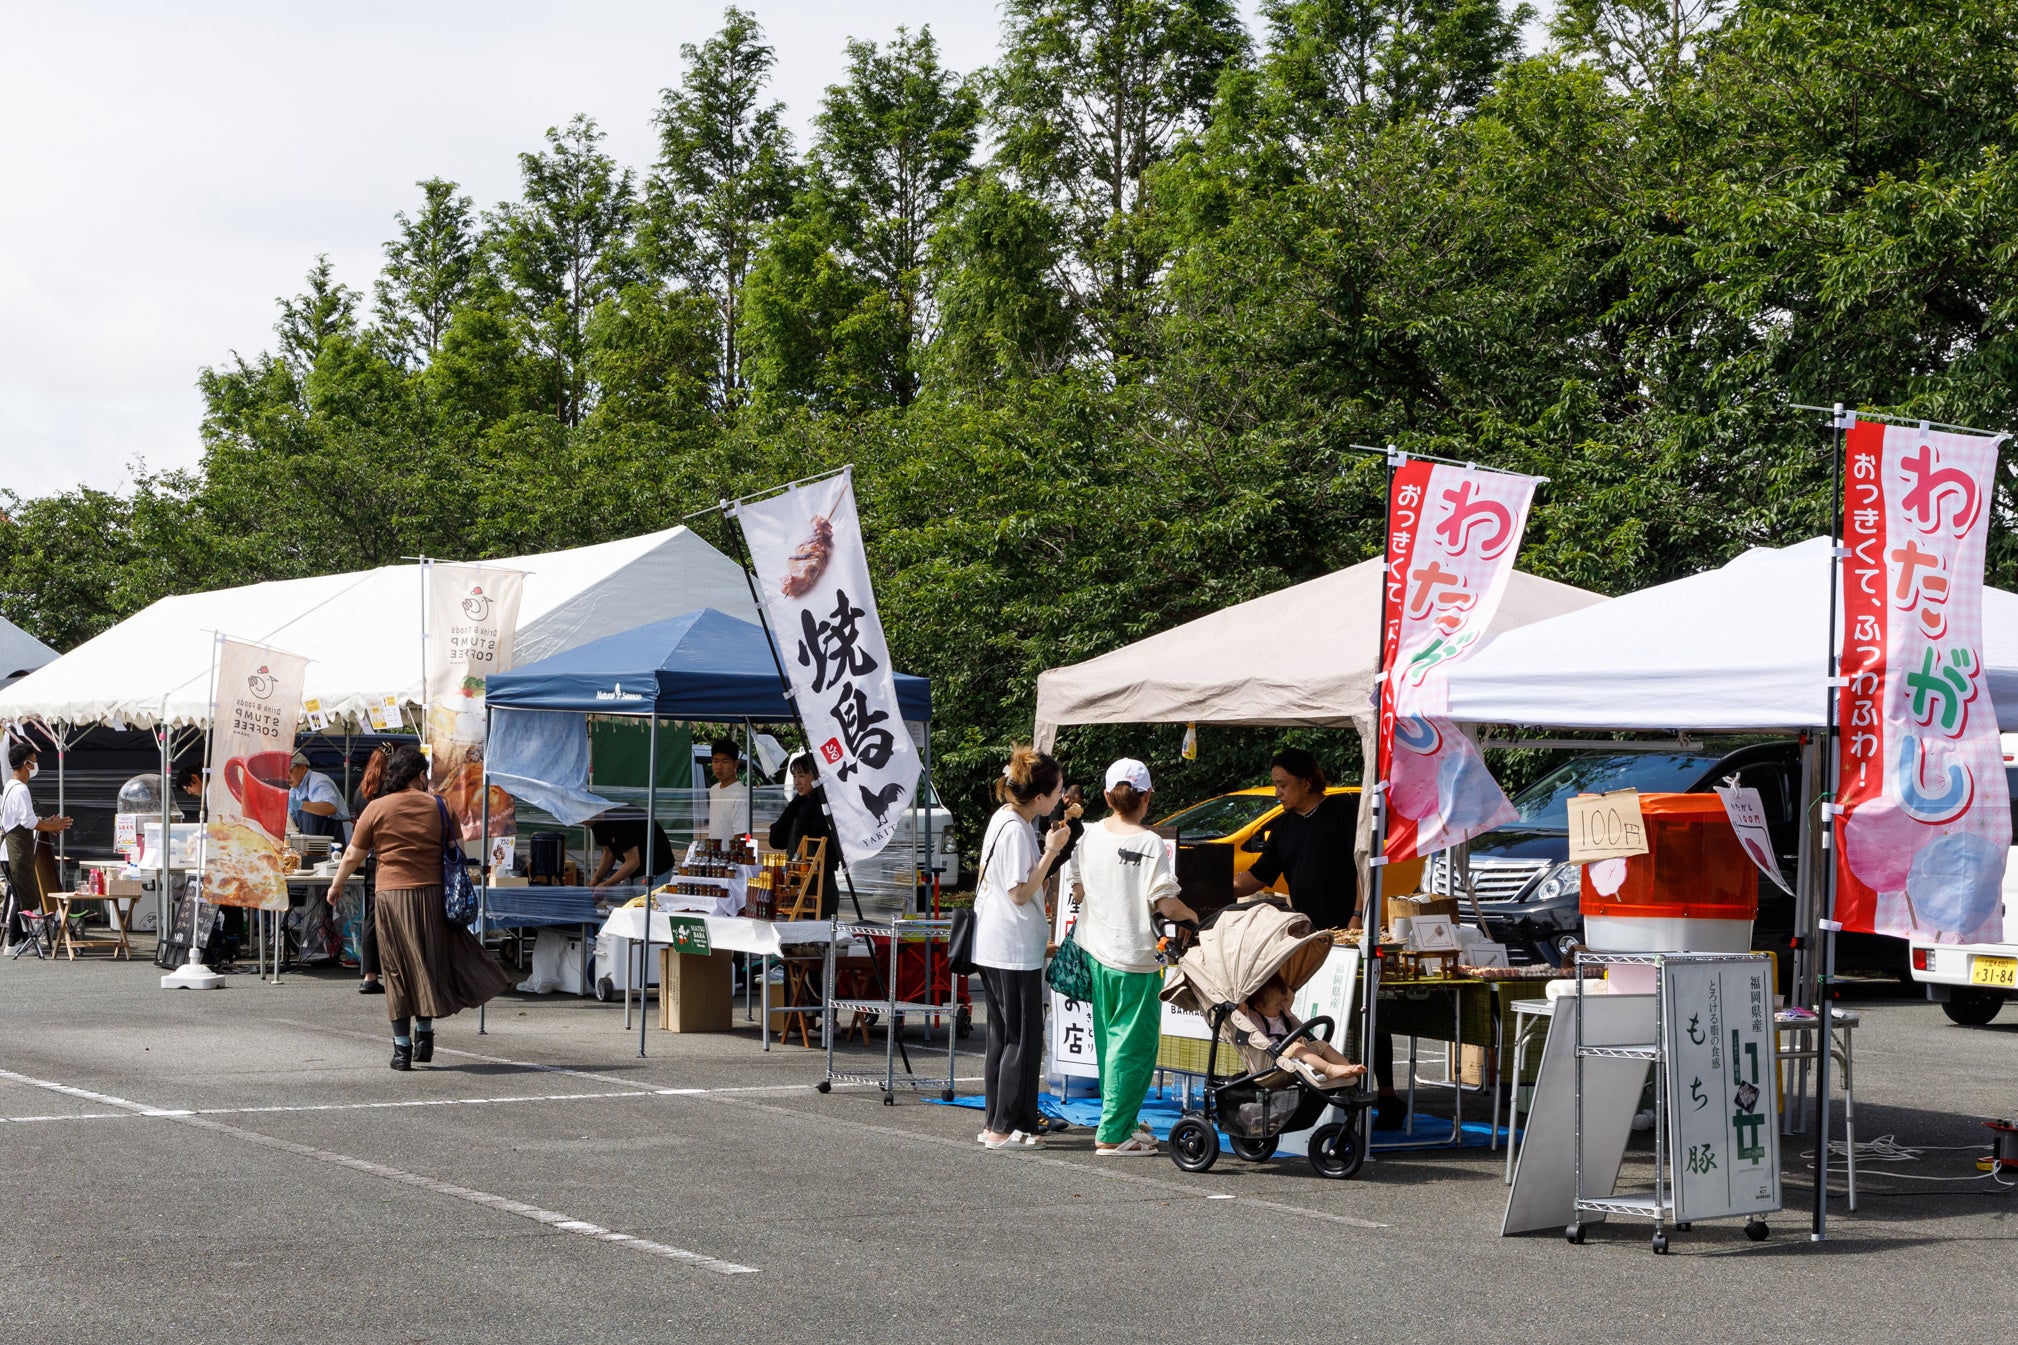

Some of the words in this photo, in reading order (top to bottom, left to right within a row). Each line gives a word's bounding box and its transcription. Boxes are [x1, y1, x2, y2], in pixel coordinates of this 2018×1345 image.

[1886, 442, 1983, 826] わたがし
[798, 588, 895, 783] 焼鳥
[1580, 807, 1642, 847] 100円
[1750, 975, 1763, 1033] 福岡県産
[1981, 968, 2014, 984] 31-84
[1086, 1002, 1094, 1053] きとり
[1708, 980, 1721, 1070] とろける脂の食感
[1685, 1012, 1718, 1175] もち豚
